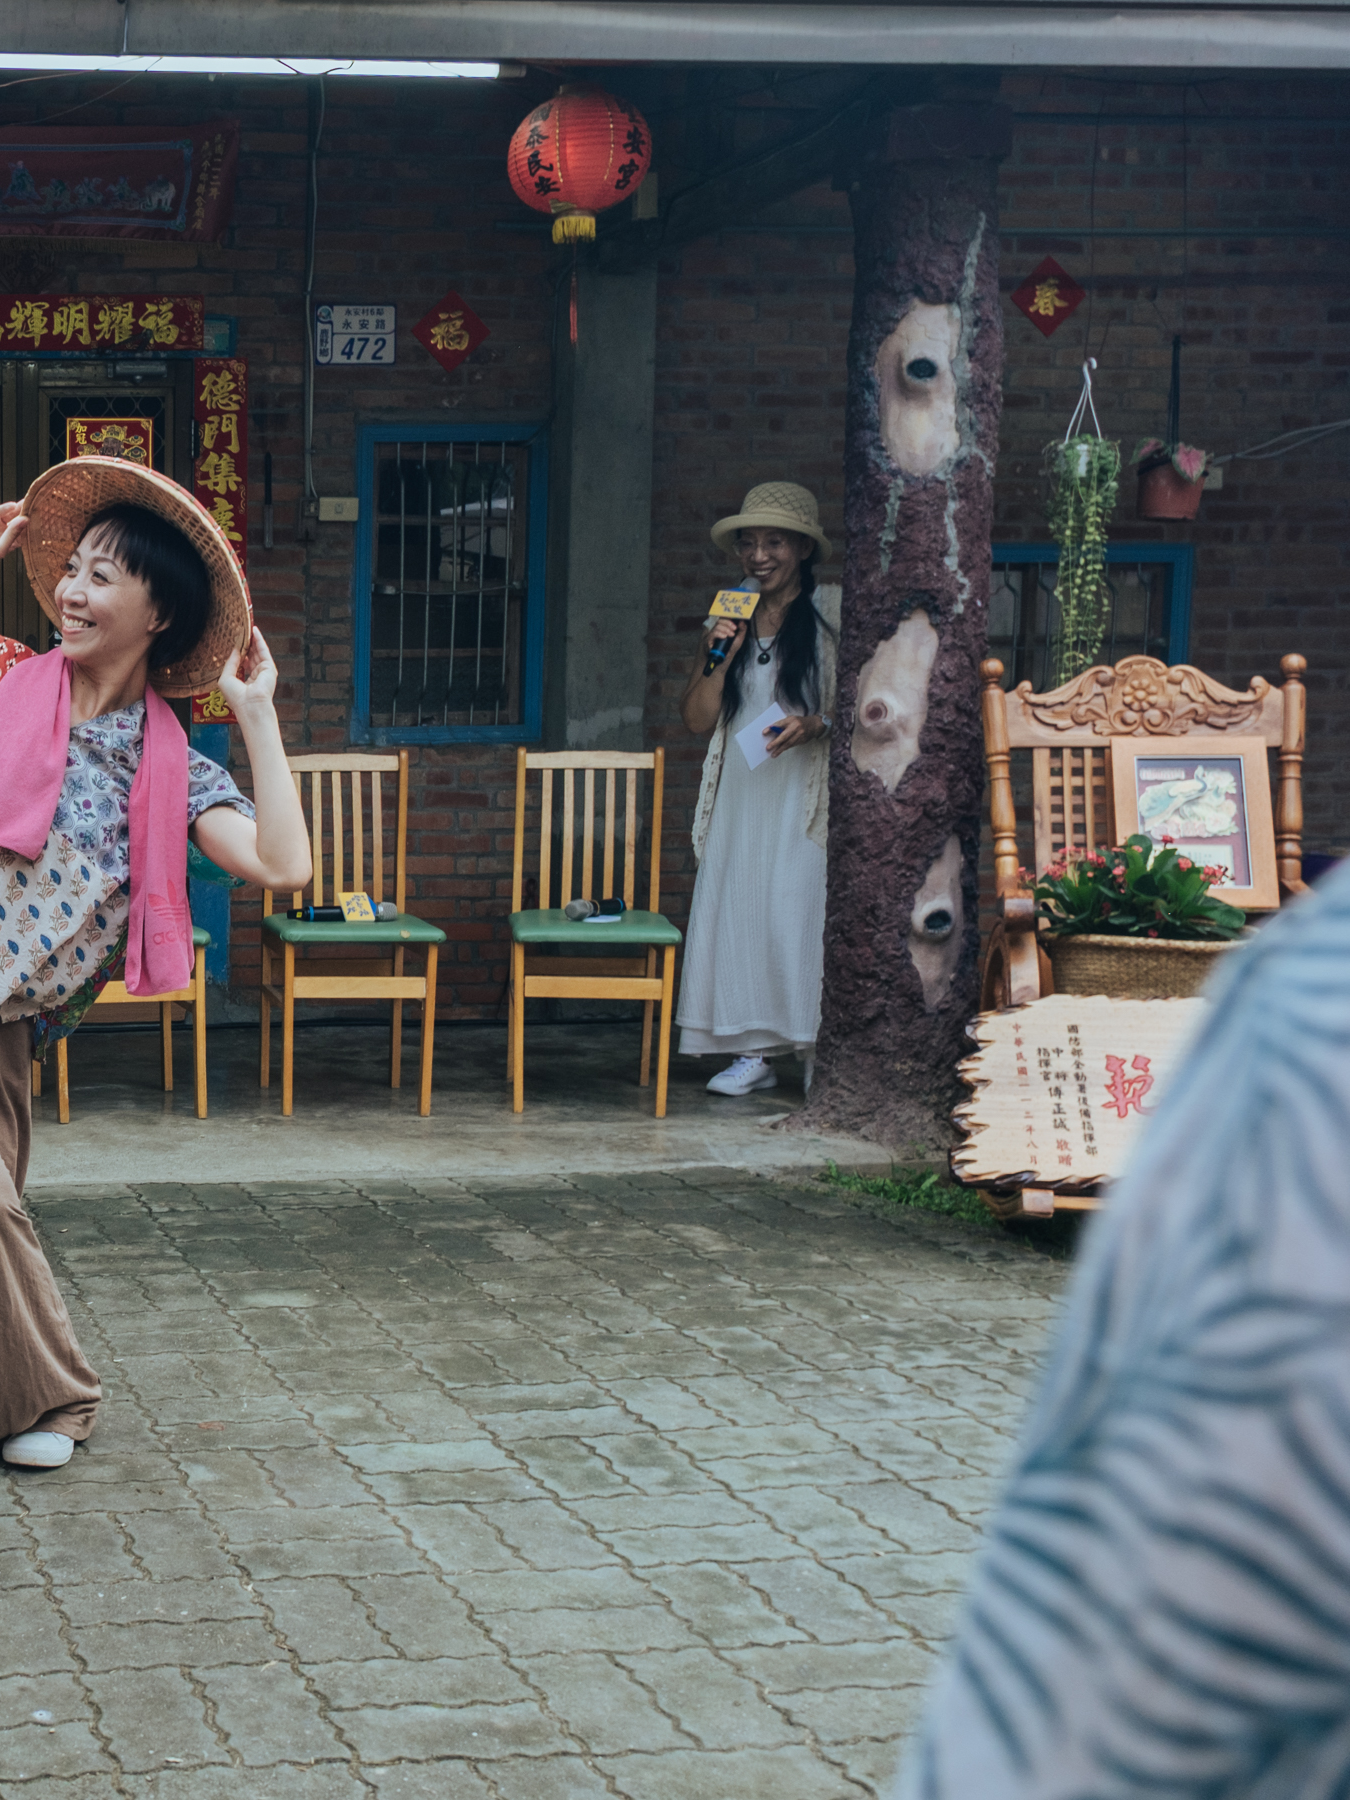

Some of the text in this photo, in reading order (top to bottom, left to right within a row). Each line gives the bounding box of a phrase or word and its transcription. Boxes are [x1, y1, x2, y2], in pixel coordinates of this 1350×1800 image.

[1029, 277, 1069, 316] 春
[342, 319, 386, 330] 永安路
[430, 310, 469, 351] 福
[341, 337, 387, 361] 472
